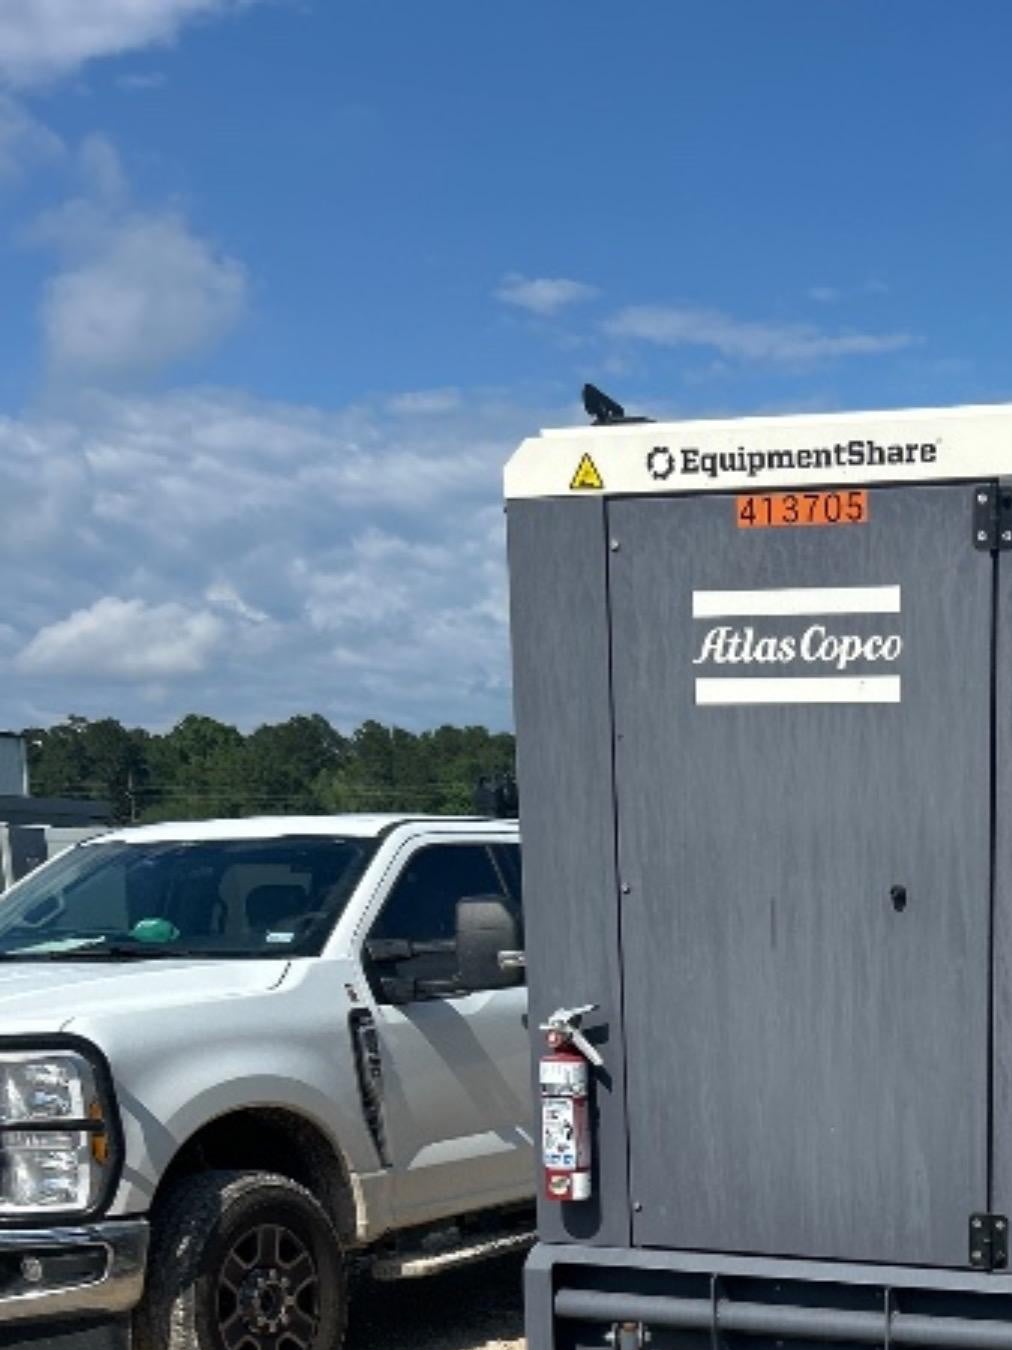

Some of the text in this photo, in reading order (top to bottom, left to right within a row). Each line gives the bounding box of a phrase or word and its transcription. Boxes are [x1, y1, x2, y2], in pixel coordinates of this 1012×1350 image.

[680, 440, 937, 478] EquipmentShare
[740, 492, 862, 525] 413705
[692, 623, 903, 670] Atlas Copco
